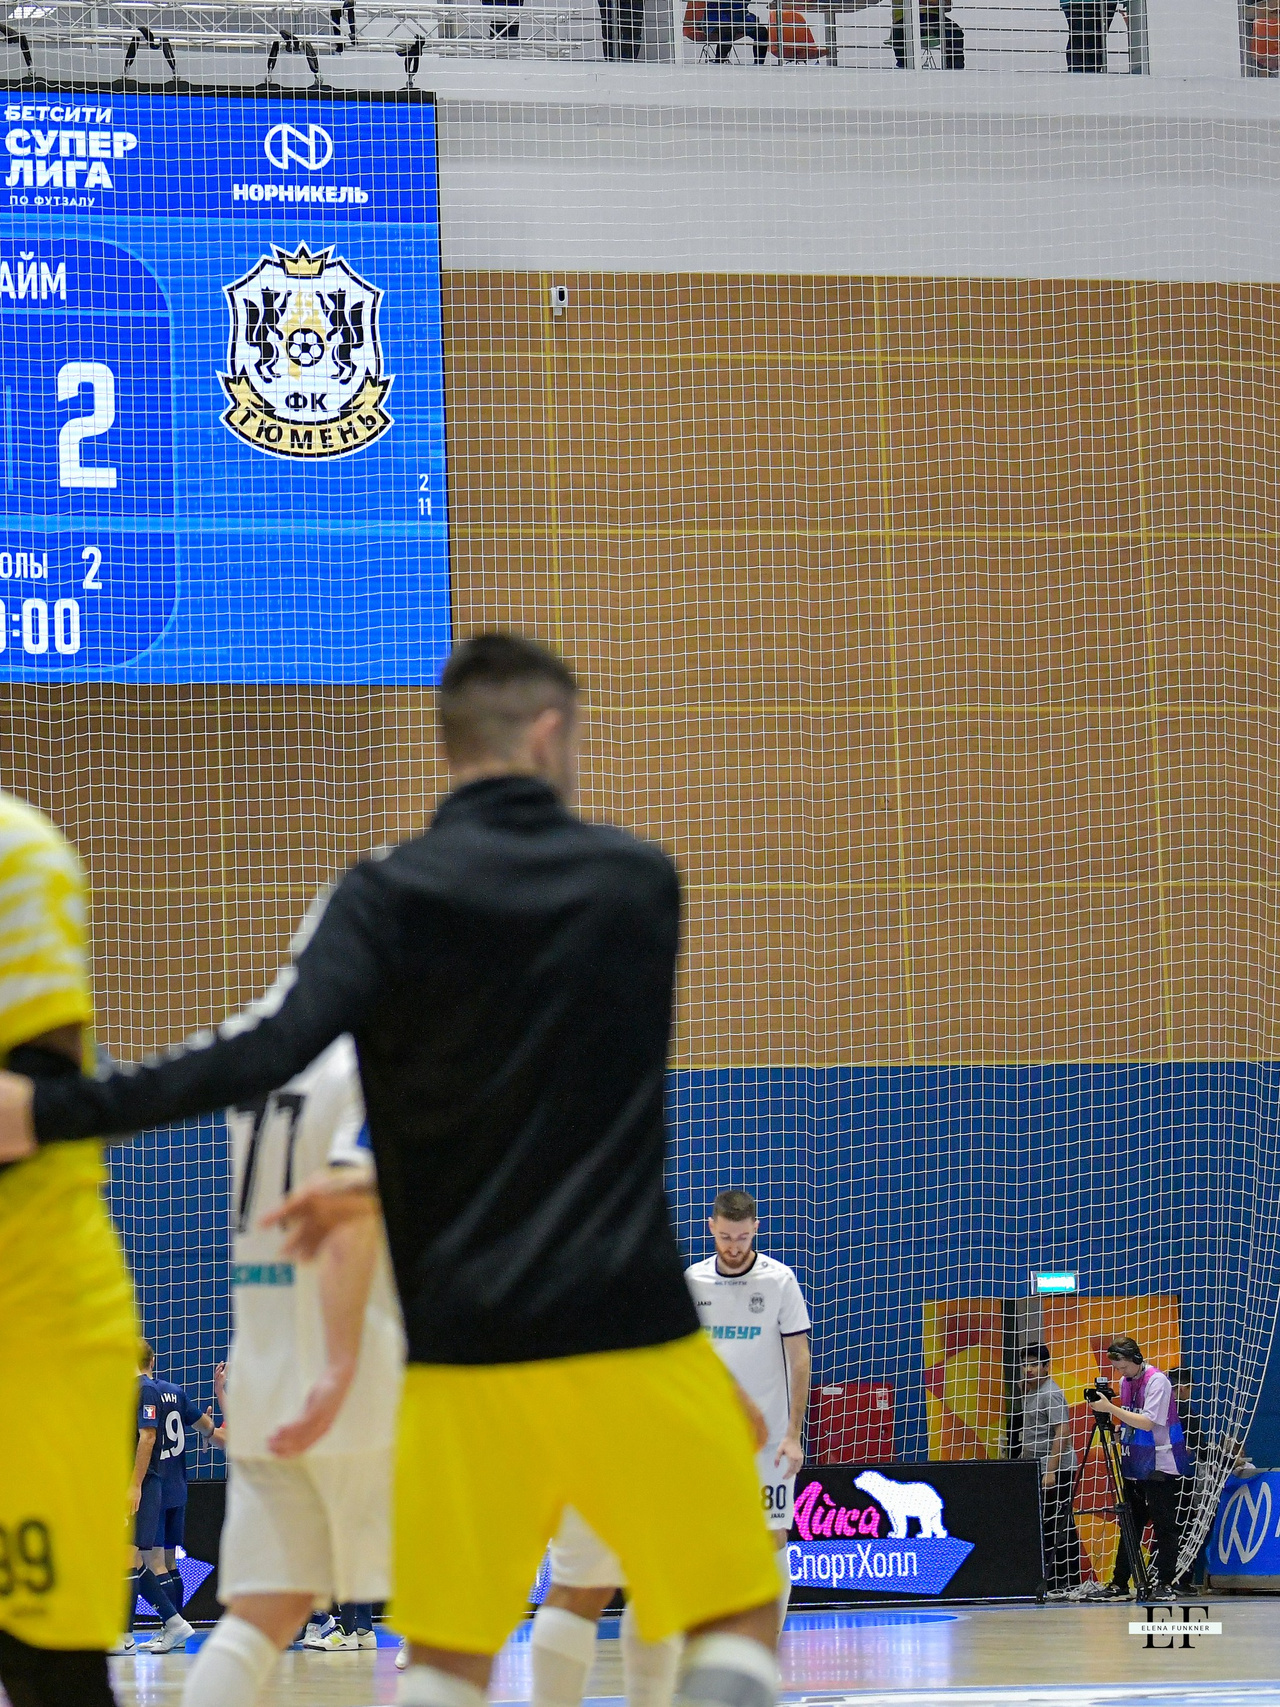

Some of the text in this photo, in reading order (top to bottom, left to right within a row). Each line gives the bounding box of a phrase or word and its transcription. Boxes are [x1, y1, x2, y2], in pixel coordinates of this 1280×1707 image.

[5, 105, 112, 123] БЕТСИТИ
[5, 129, 138, 159] СУПЕР
[5, 160, 113, 189] ЛИГА
[9, 195, 96, 208] ПО ФУТЗАЛУ
[233, 183, 370, 204] НОРНИКЕЛЬ
[284, 392, 327, 413] ФК
[57, 361, 117, 489] 2
[238, 409, 379, 451] ТЮМЕНЬ
[419, 474, 429, 491] 2
[418, 497, 431, 516] 11
[81, 546, 103, 590] 2
[761, 1484, 787, 1510] 80
[786, 1543, 918, 1588] СпортХолл
